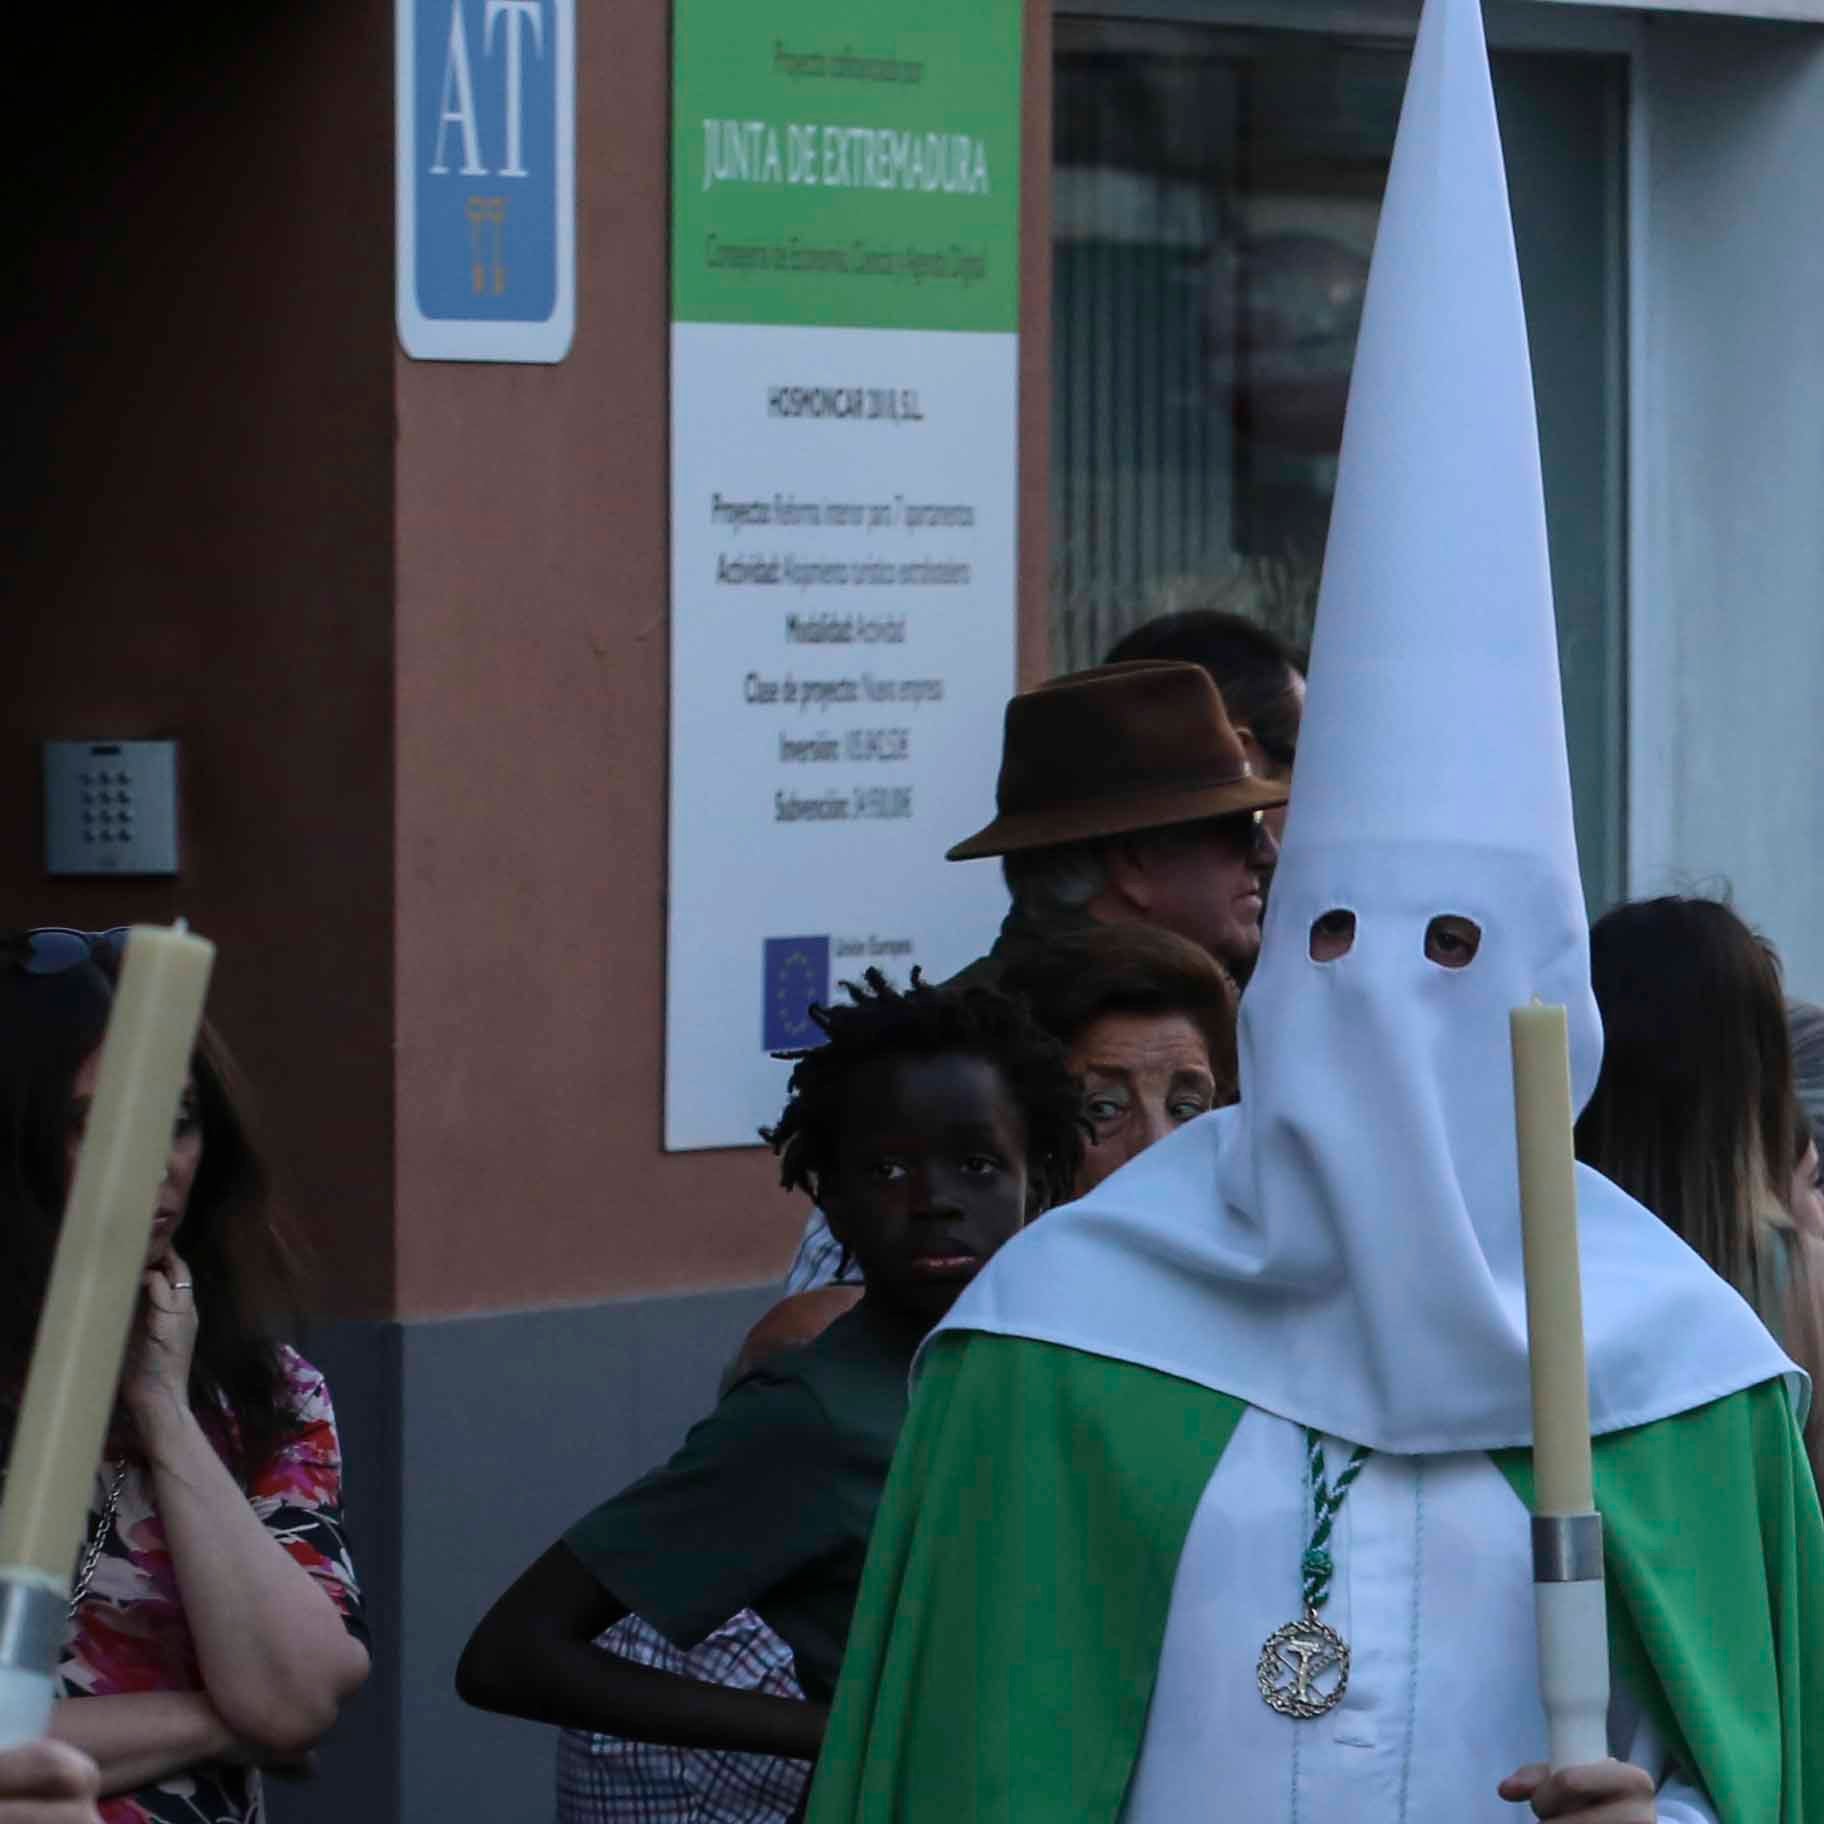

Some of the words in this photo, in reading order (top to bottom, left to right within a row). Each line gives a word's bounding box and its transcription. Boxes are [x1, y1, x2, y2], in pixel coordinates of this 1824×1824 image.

[428, 0, 545, 177] AT
[702, 118, 783, 191] JUNTA
[785, 123, 818, 184] DE
[822, 125, 990, 195] EXTREMADURA
